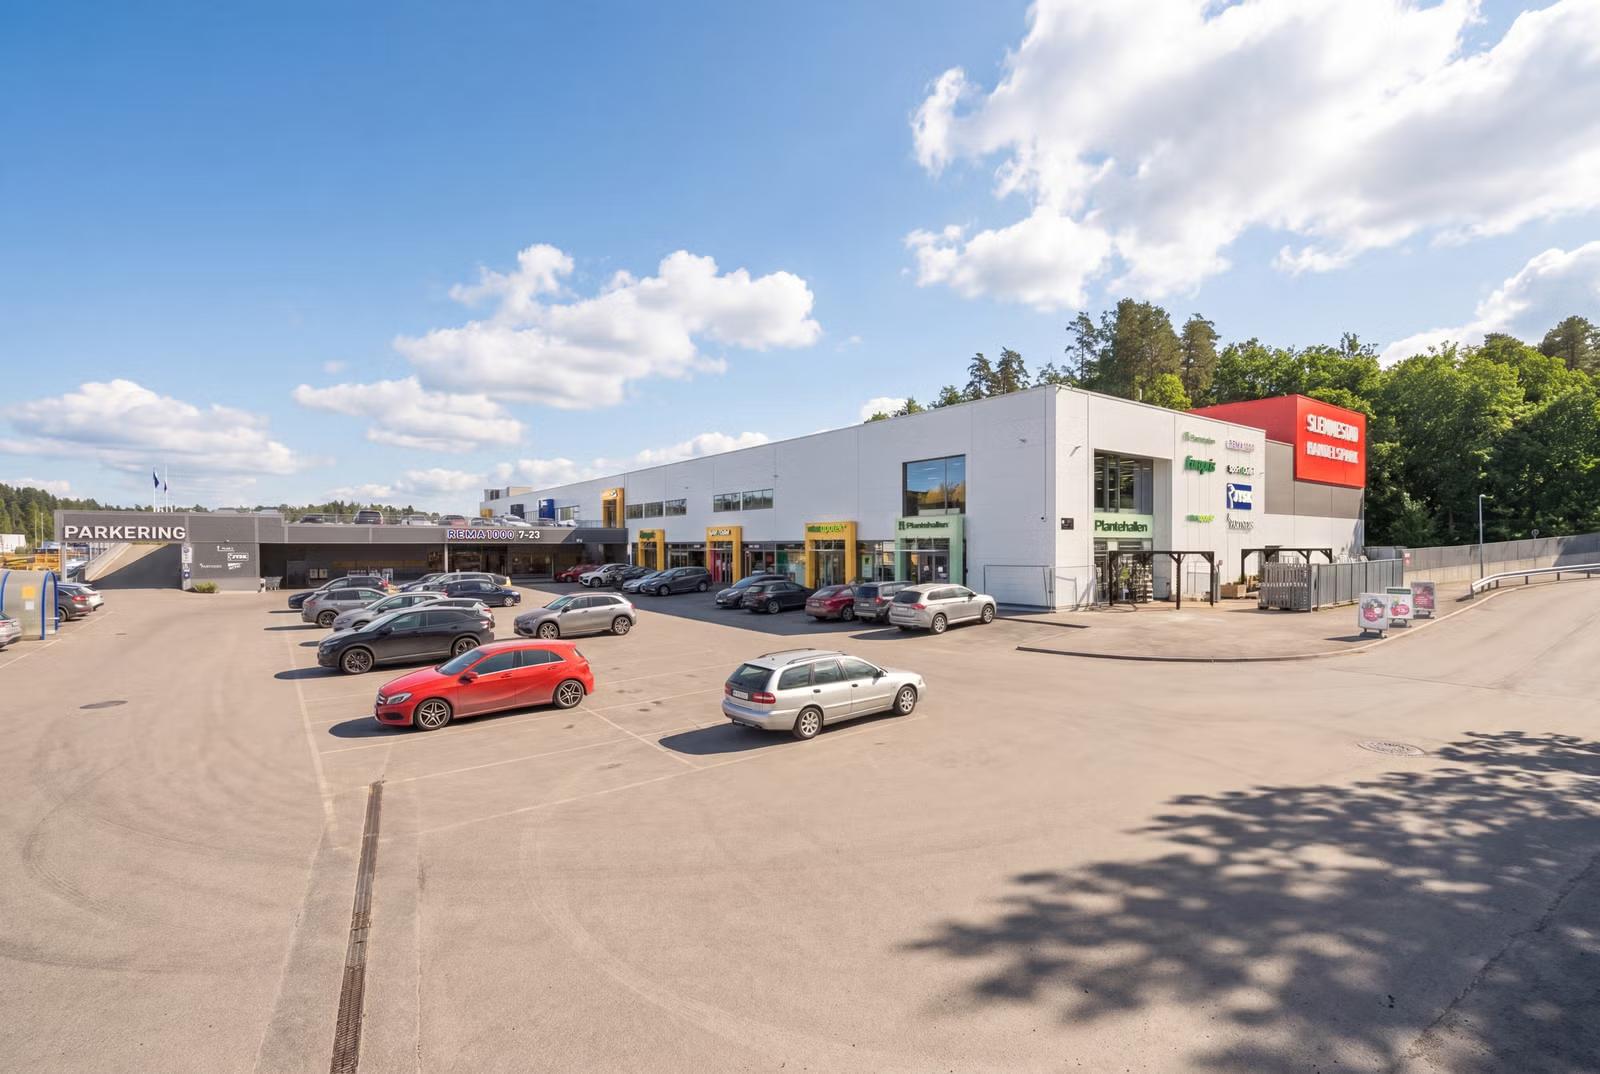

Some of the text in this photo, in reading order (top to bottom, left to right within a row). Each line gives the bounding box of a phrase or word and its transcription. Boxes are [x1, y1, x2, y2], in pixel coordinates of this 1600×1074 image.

[1232, 489, 1253, 503] JYSK
[906, 521, 949, 529] Plantehallen
[1094, 520, 1148, 532] Plantehallen
[64, 525, 186, 539] PARKERING
[518, 530, 541, 539] 7-23
